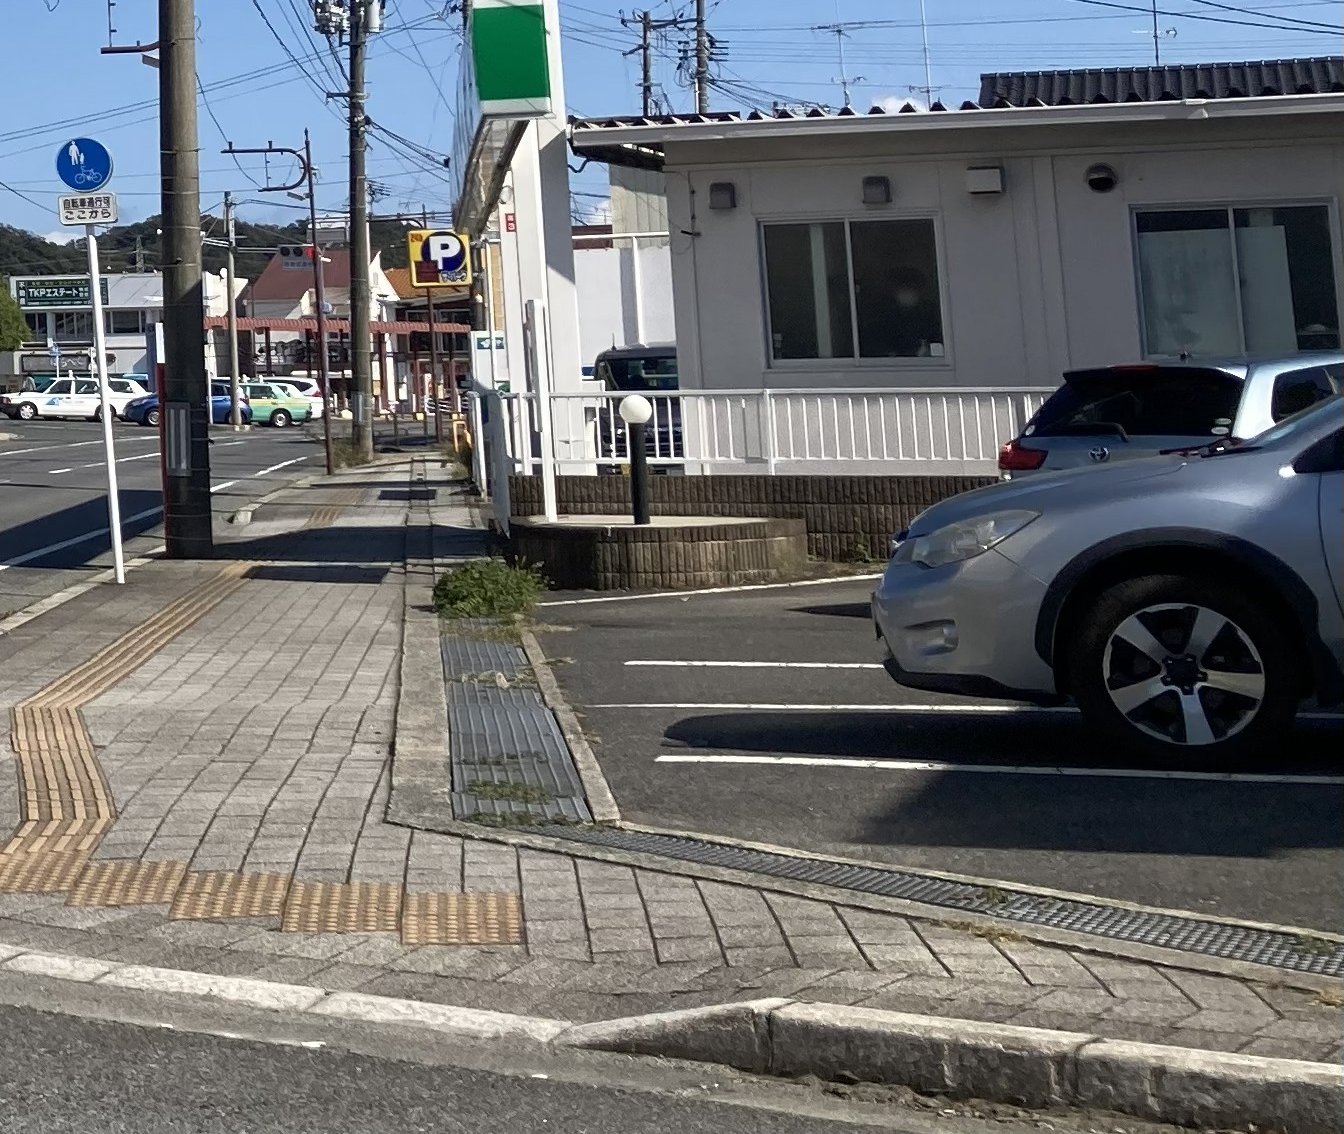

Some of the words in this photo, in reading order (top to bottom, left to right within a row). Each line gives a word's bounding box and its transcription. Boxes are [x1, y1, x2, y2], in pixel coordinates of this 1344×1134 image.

[64, 208, 111, 220] ここから
[429, 235, 460, 270] P
